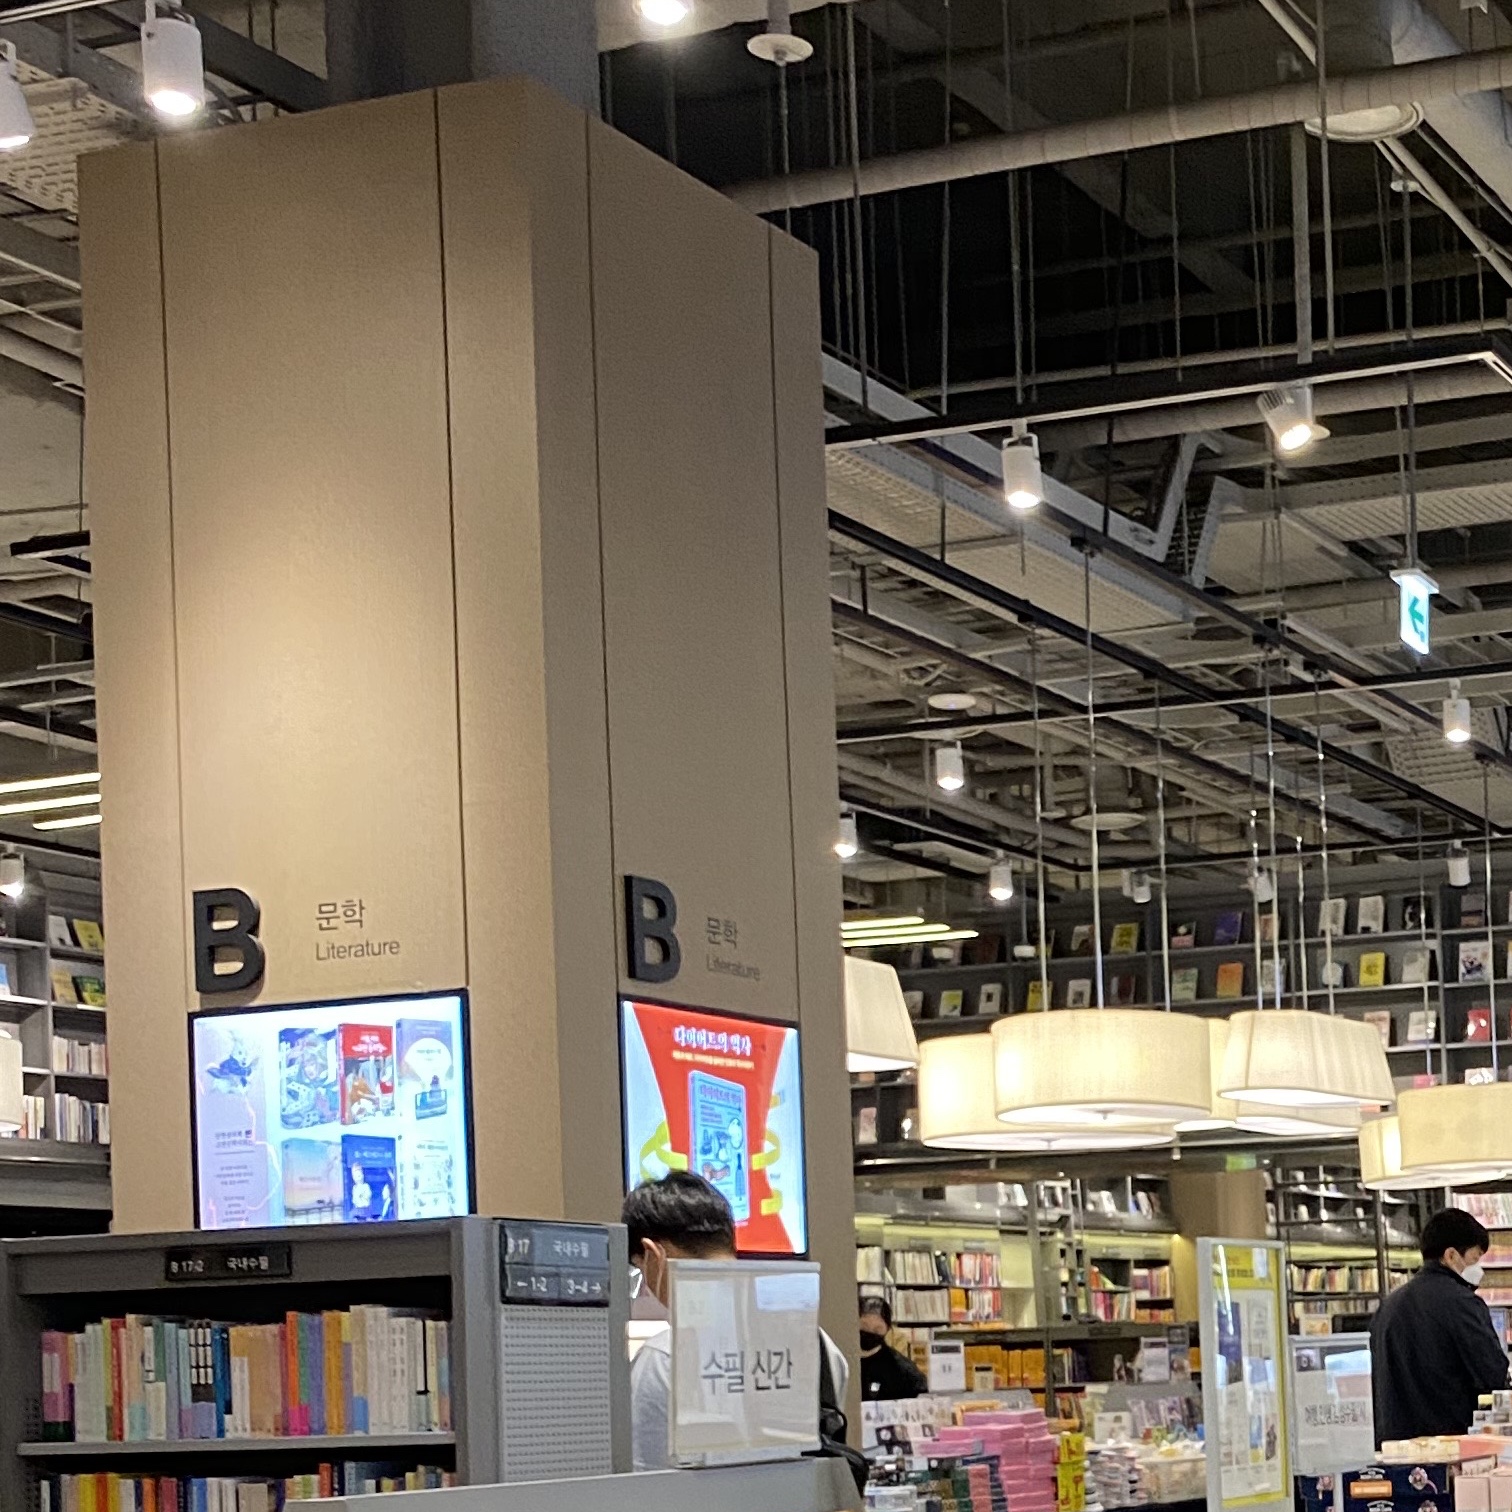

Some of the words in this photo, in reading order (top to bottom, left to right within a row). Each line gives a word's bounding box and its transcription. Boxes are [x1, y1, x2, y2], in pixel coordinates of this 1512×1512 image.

[315, 898, 366, 932] 문학
[624, 875, 681, 984] B
[706, 917, 738, 949] 문학
[193, 887, 265, 994] B
[315, 939, 401, 962] Literature
[701, 1350, 746, 1396] 수필
[751, 1347, 794, 1391] 신간
